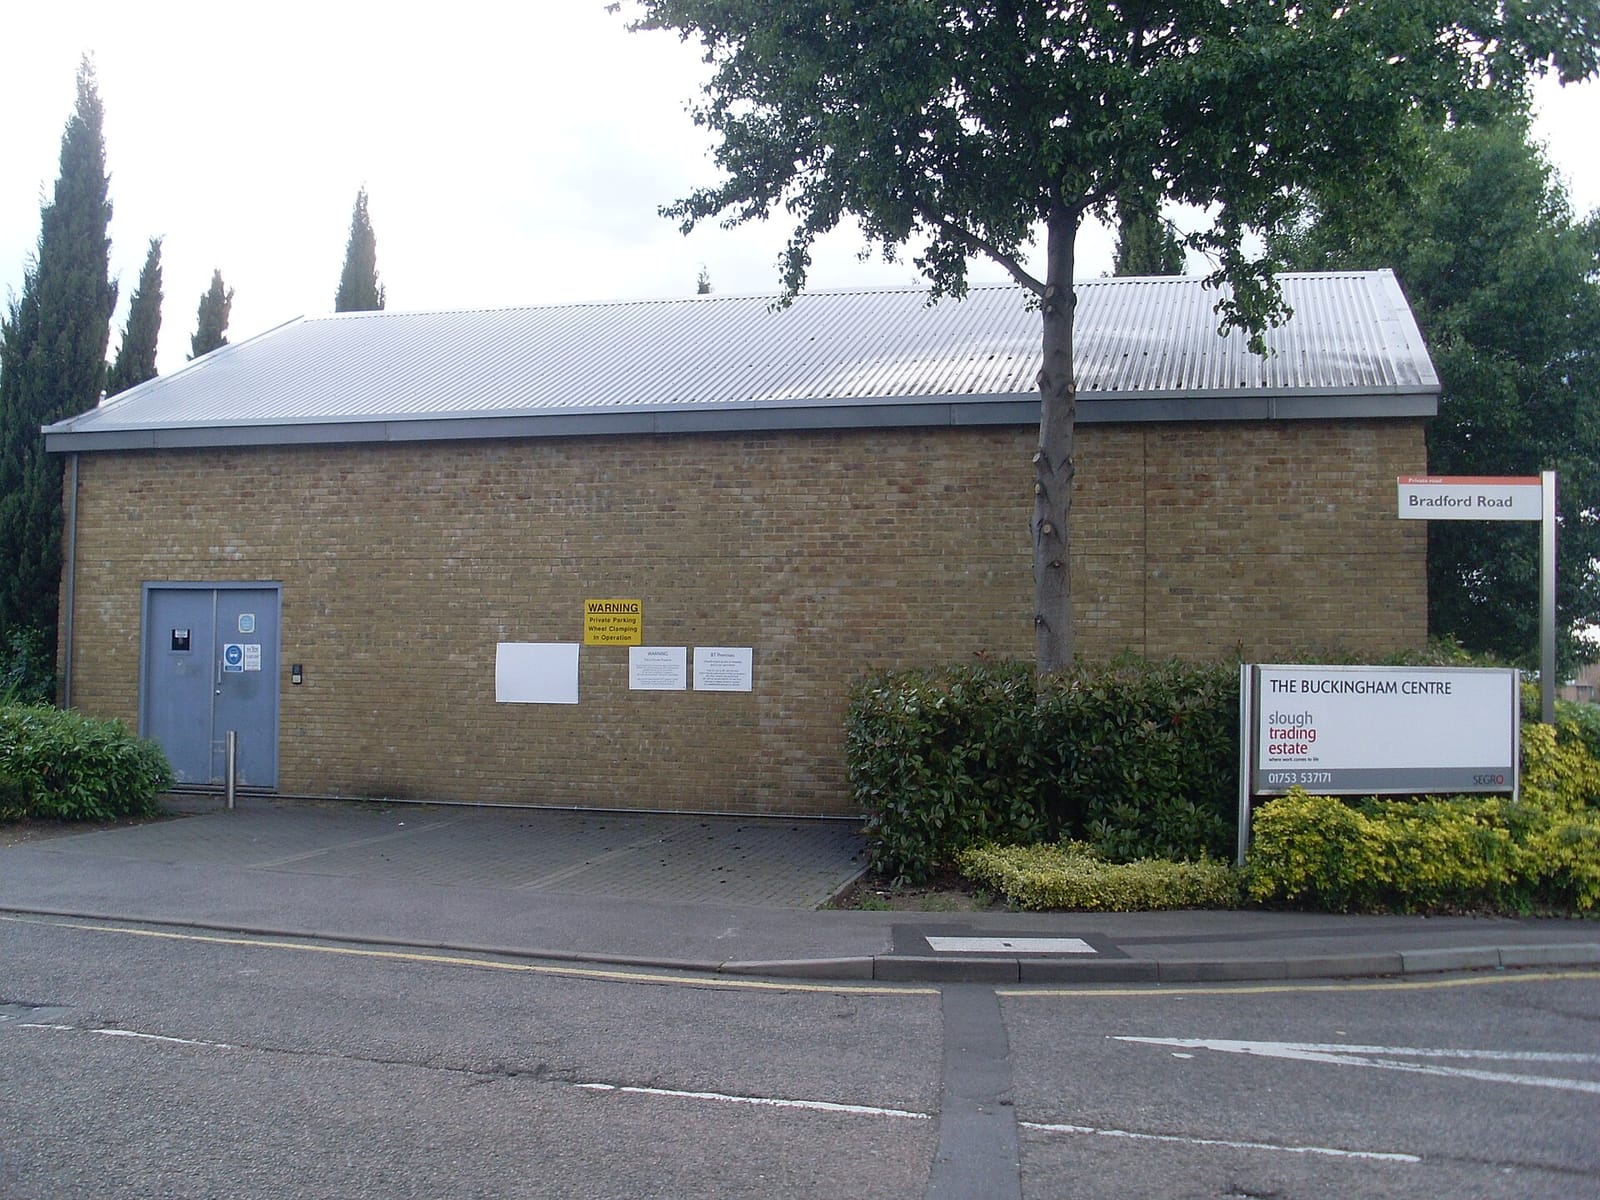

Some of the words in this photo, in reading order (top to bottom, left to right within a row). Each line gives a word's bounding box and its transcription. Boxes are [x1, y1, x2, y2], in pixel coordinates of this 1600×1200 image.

[1409, 495, 1472, 507] Bradford
[1477, 496, 1513, 507] Road
[588, 603, 638, 613] WARNING
[1270, 680, 1297, 693] THE
[1301, 680, 1398, 694] BUCKINGHAM
[1402, 681, 1452, 695] CENTRE
[1268, 711, 1313, 728] slough
[1269, 726, 1316, 743] trading
[1268, 743, 1308, 755] estate
[1268, 772, 1297, 784] 01753
[1300, 772, 1332, 784] 537171
[1472, 774, 1504, 785] SEGRO
